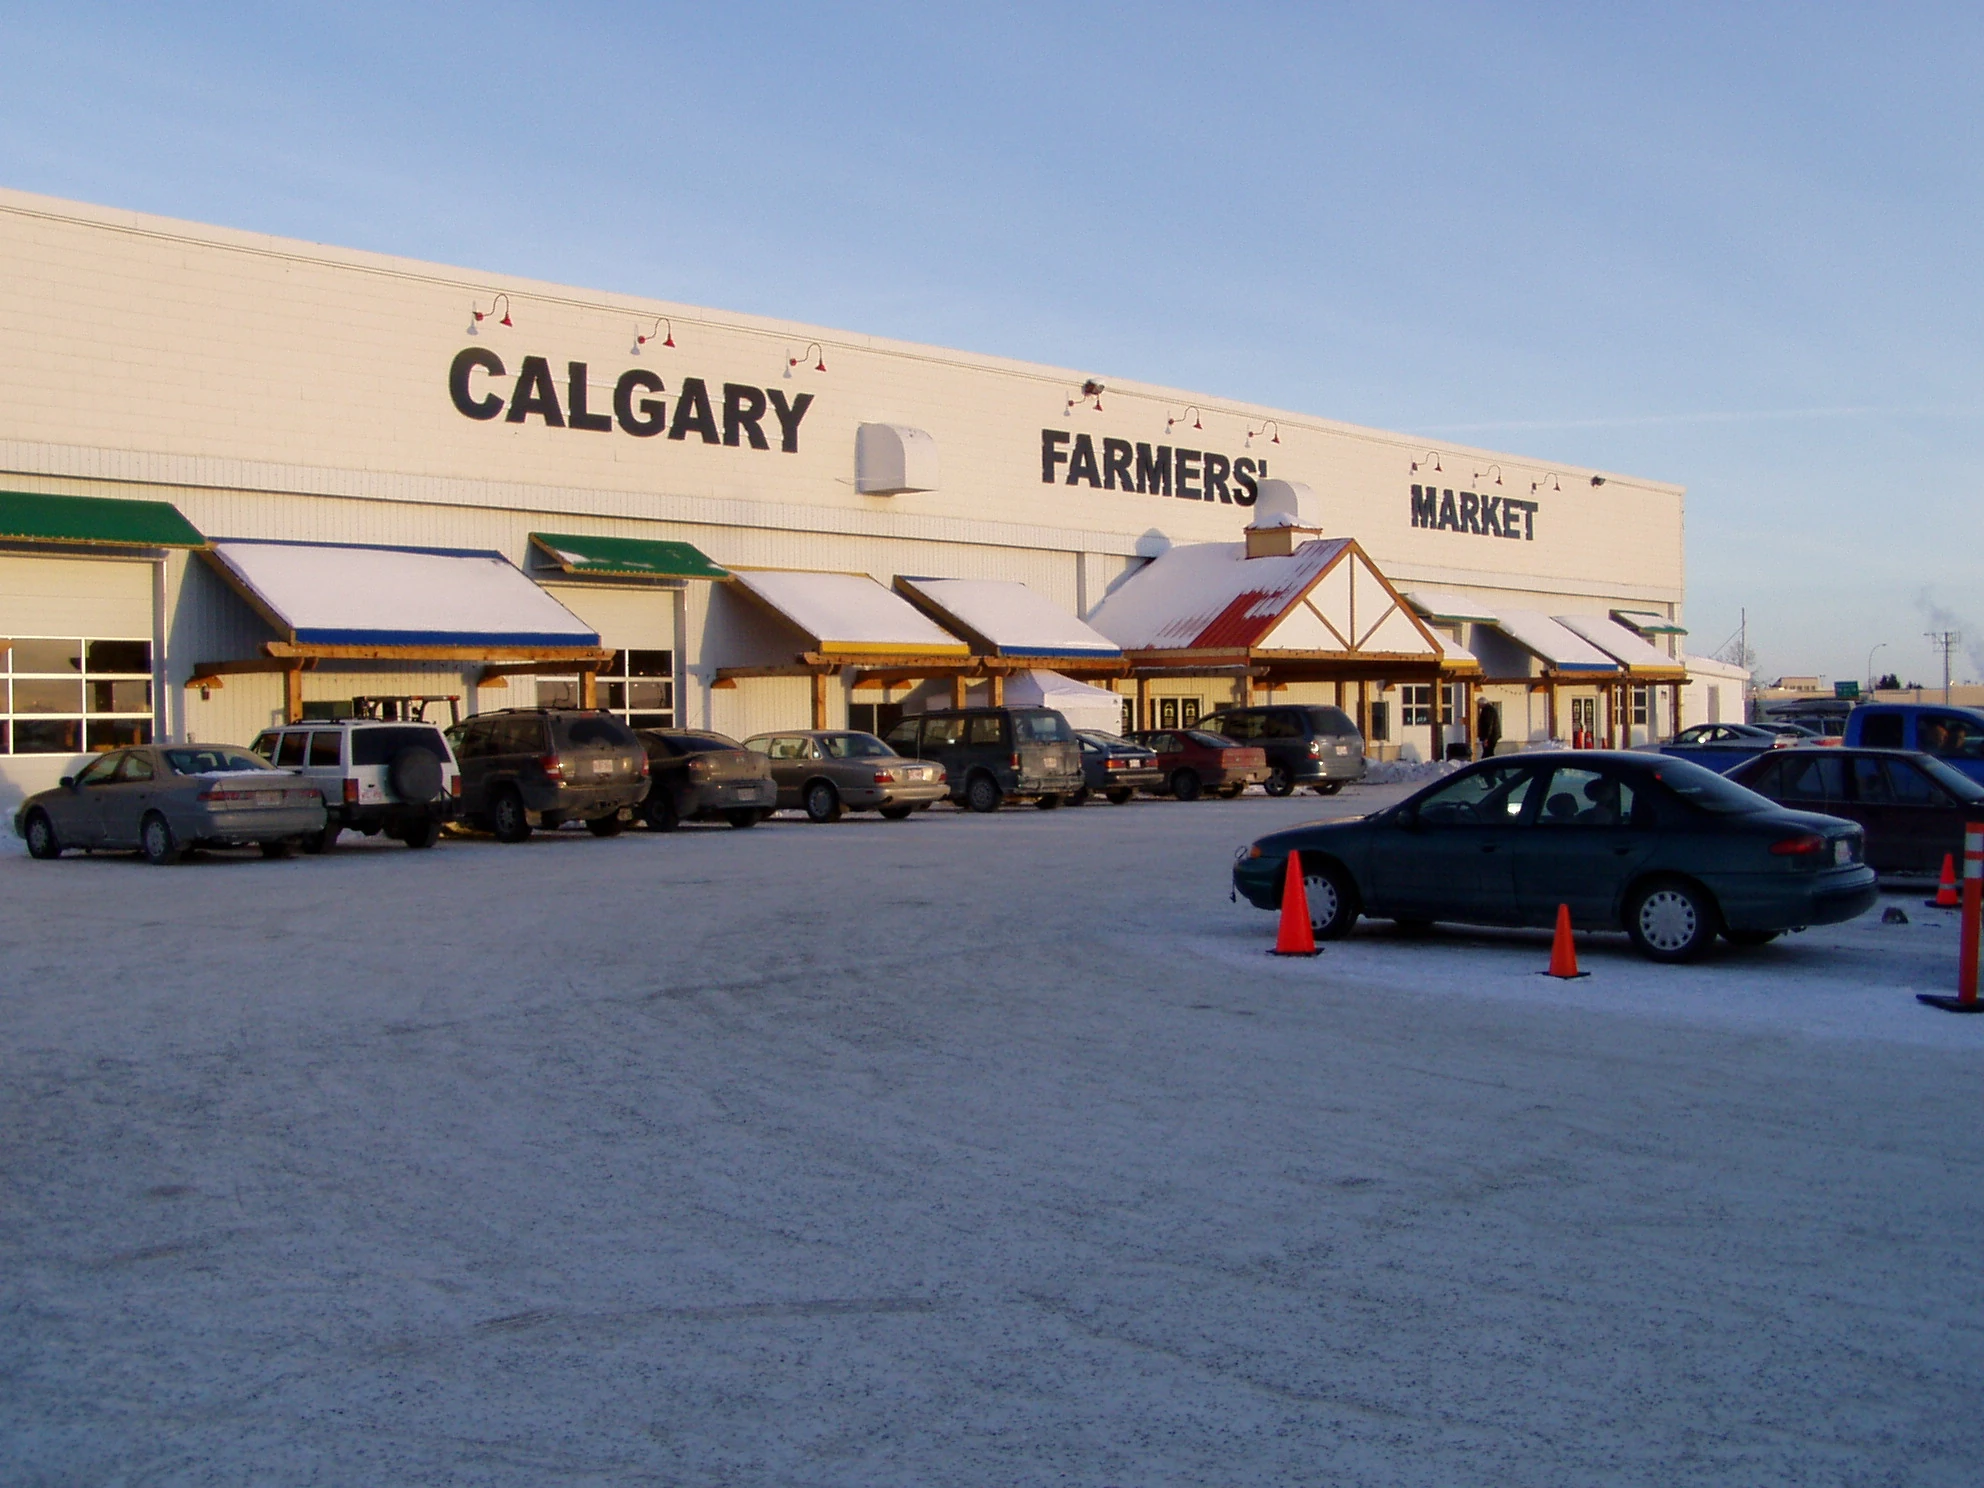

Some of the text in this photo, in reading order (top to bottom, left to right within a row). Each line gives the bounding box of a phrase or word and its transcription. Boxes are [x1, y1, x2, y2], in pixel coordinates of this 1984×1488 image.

[449, 346, 1539, 541] CALGARY FARMERS' MARKET
